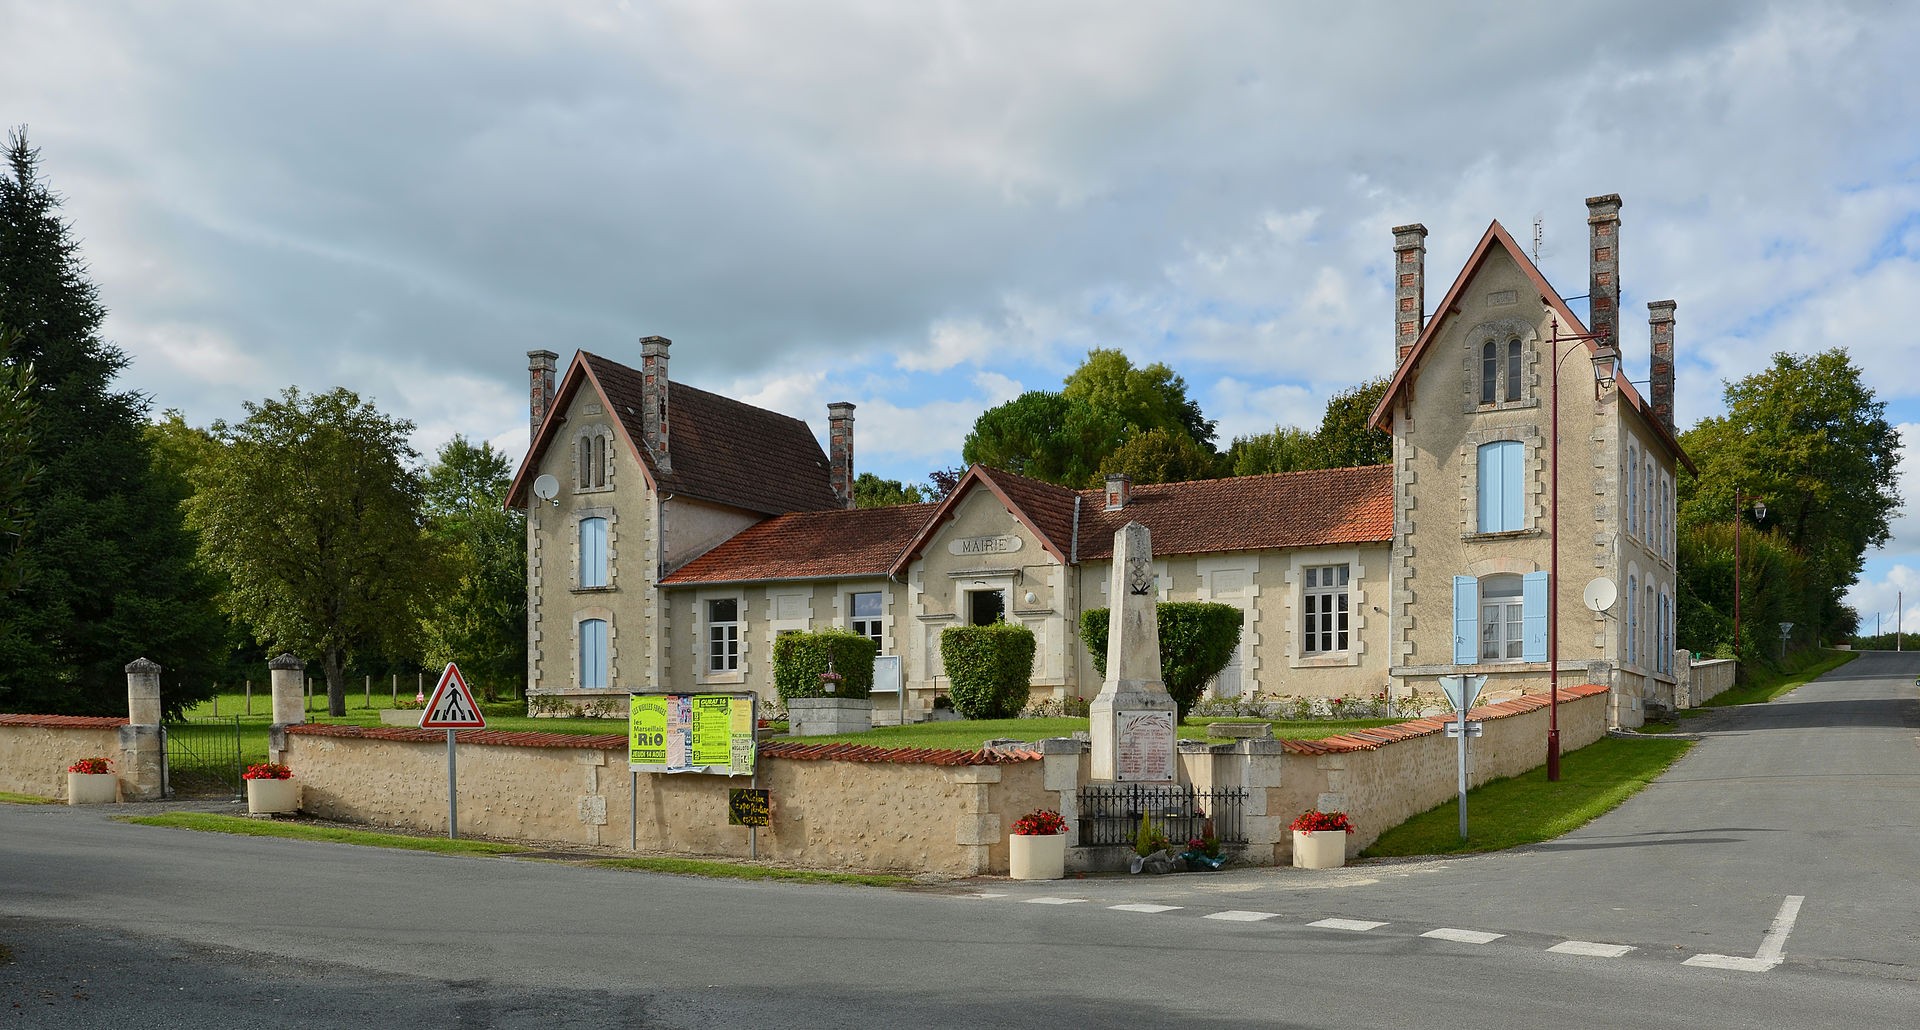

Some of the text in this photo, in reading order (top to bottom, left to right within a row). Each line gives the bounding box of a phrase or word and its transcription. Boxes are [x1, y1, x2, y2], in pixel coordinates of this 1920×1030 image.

[962, 539, 1007, 553] MAIRIE
[631, 707, 639, 716] LES
[632, 750, 646, 758] JEUDI
[646, 750, 652, 758] 14
